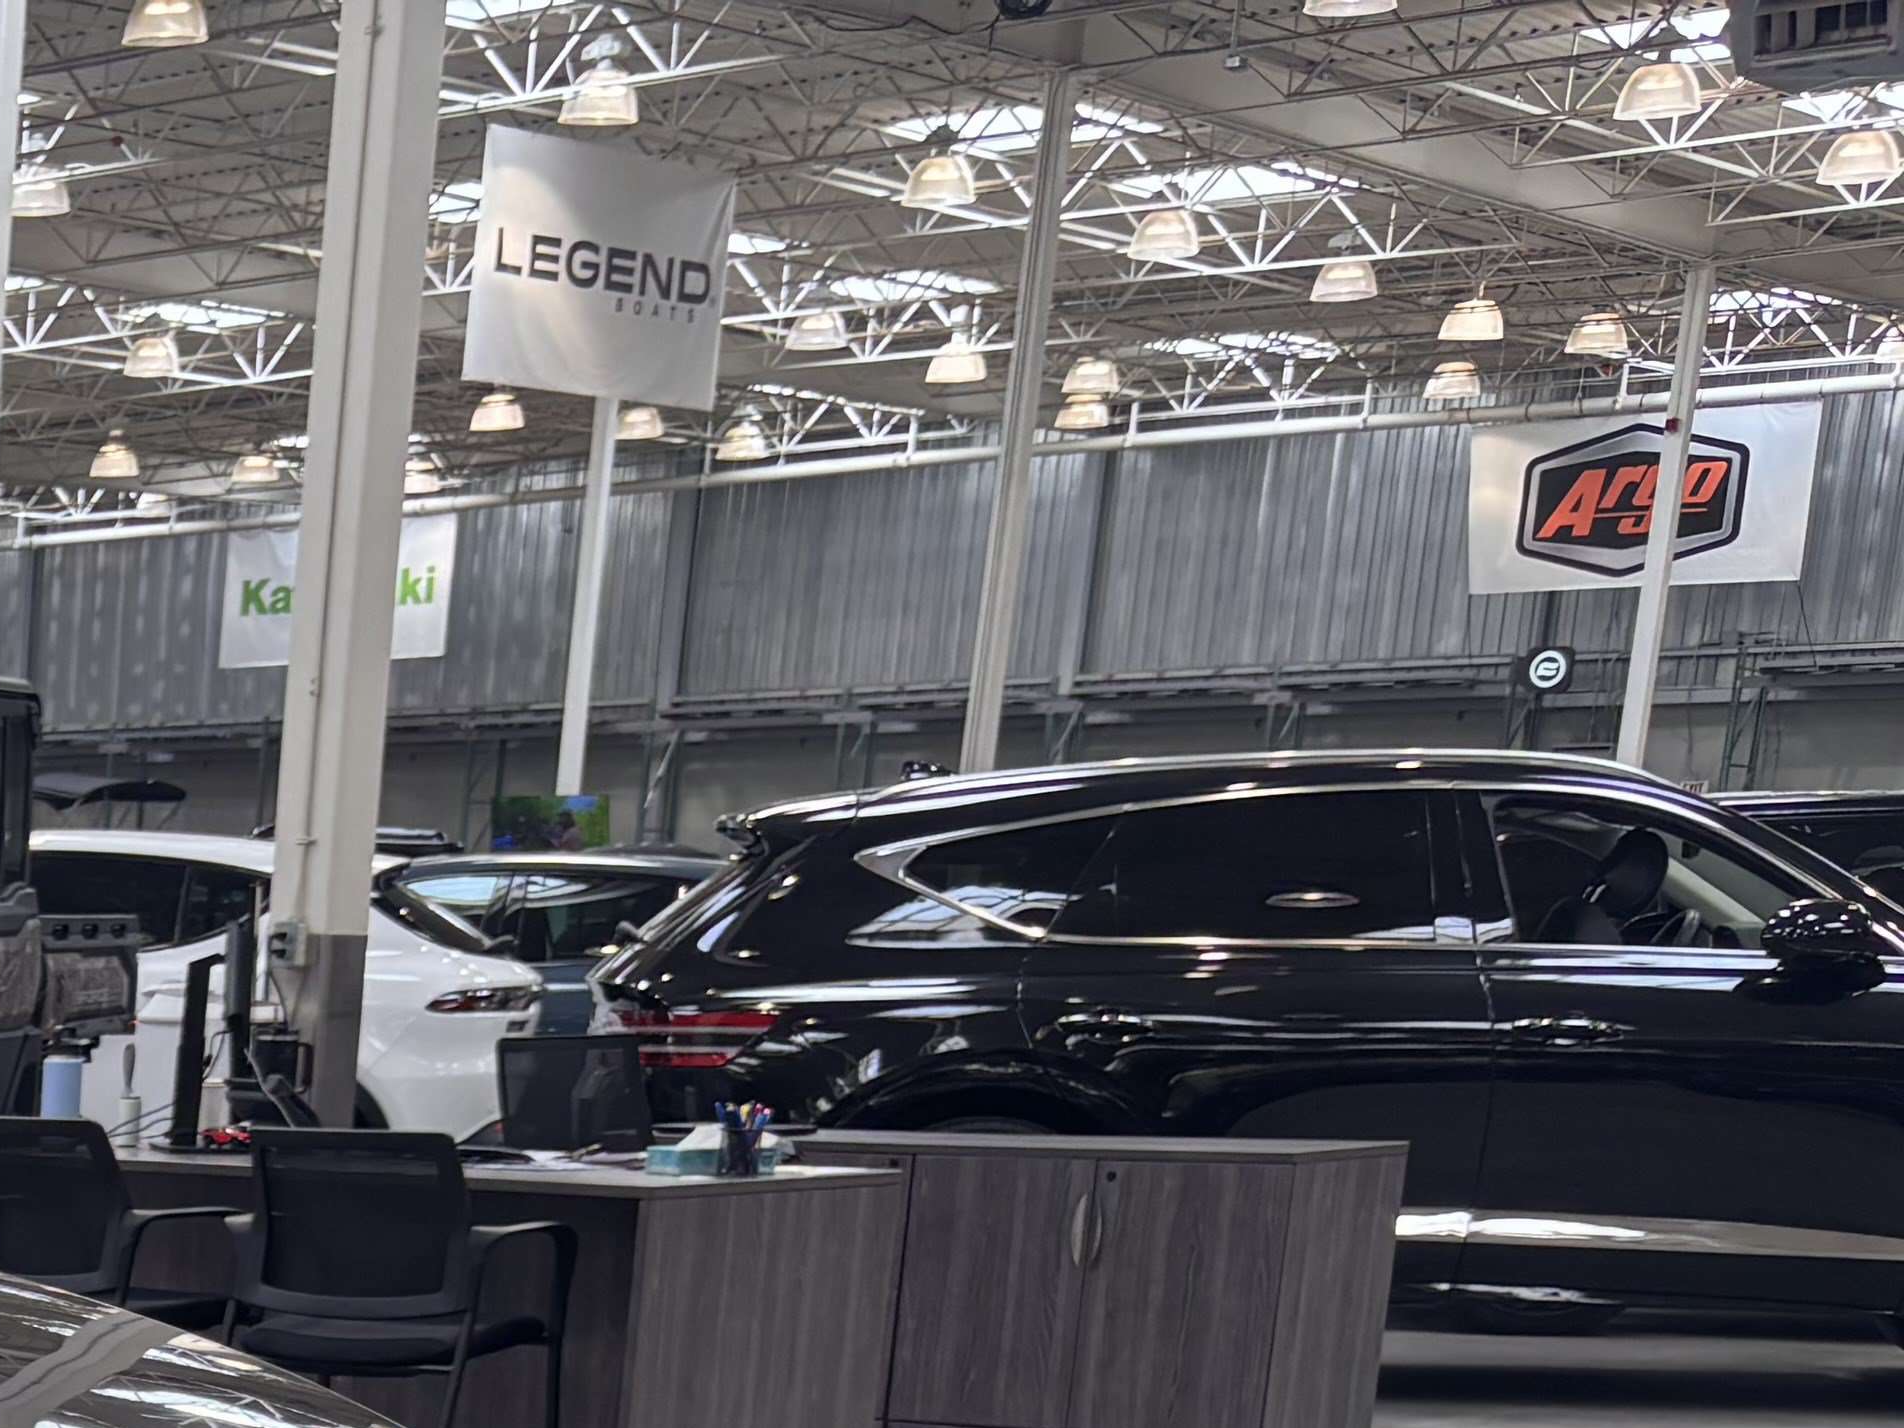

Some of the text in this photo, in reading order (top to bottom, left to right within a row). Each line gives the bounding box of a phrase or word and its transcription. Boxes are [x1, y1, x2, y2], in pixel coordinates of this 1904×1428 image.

[494, 227, 712, 305] LEGEND
[615, 298, 695, 324] BOATS
[239, 565, 436, 617] Kaki
